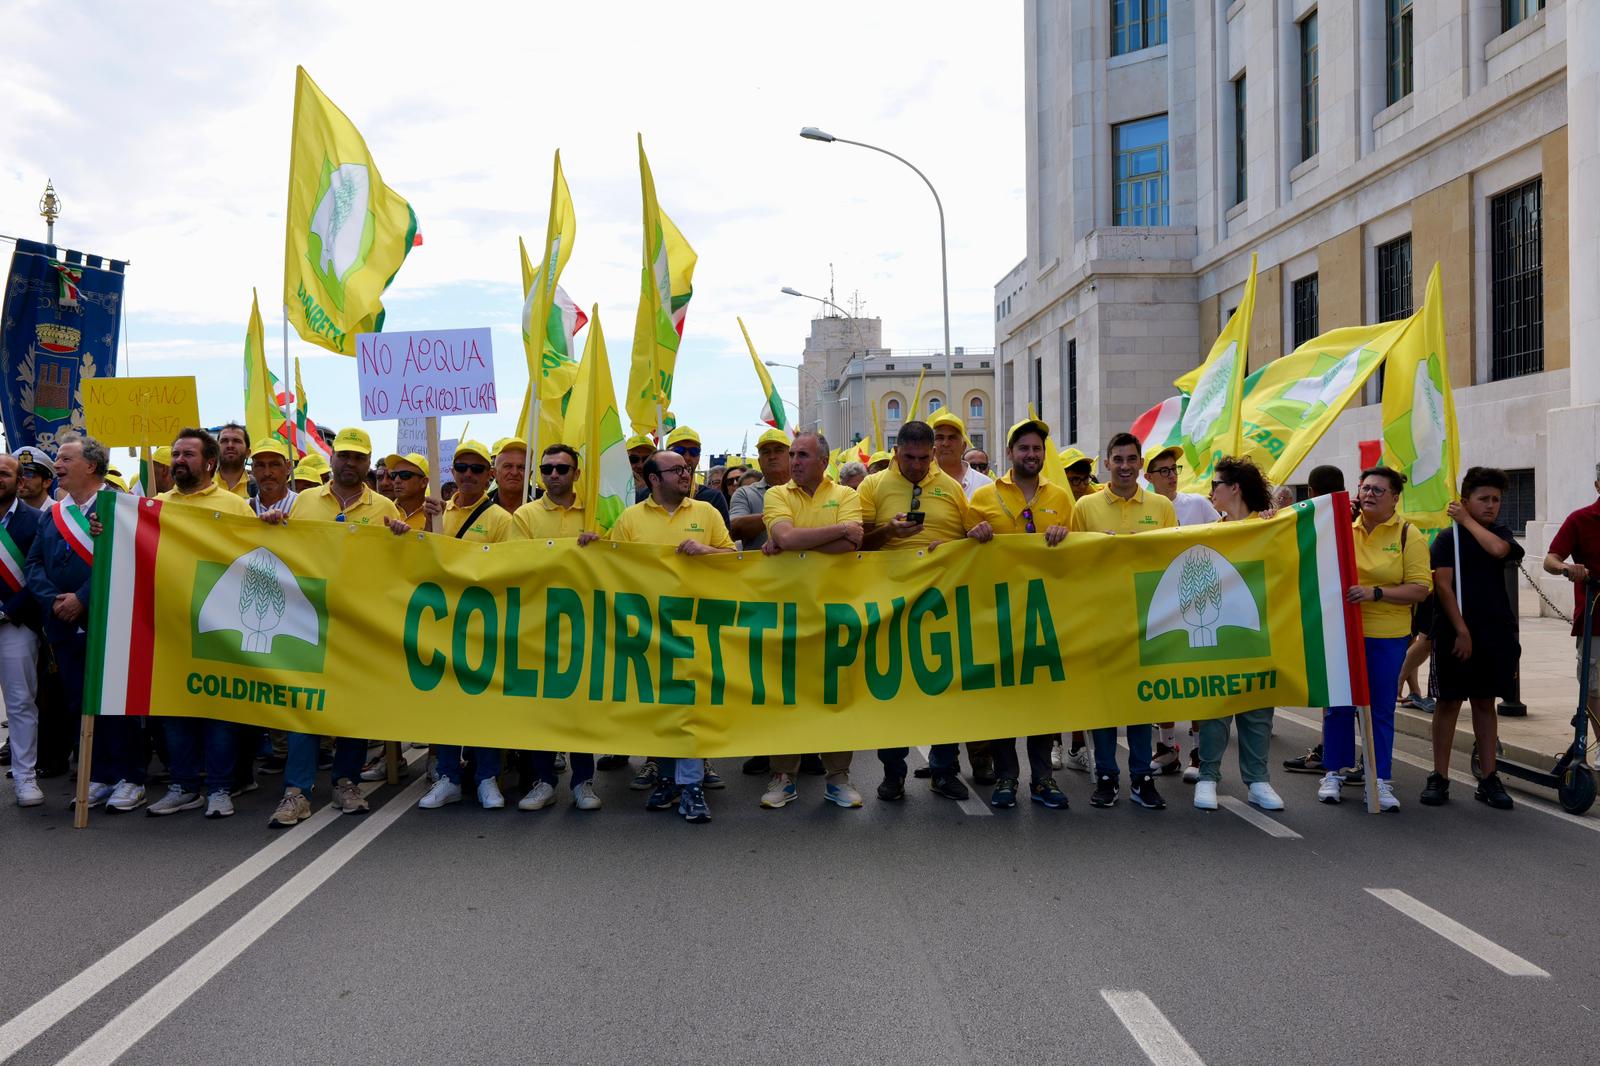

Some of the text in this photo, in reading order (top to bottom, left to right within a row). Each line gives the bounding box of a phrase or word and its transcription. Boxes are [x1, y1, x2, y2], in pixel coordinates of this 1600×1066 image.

[361, 335, 392, 376] NO
[90, 385, 119, 406] NO
[364, 386, 389, 416] NO
[93, 415, 116, 435] NO
[404, 578, 1067, 705] COLDIRETTI PUGLIA
[187, 672, 326, 711] COLDIRETTI
[1137, 671, 1277, 702] COLDIRETTI
